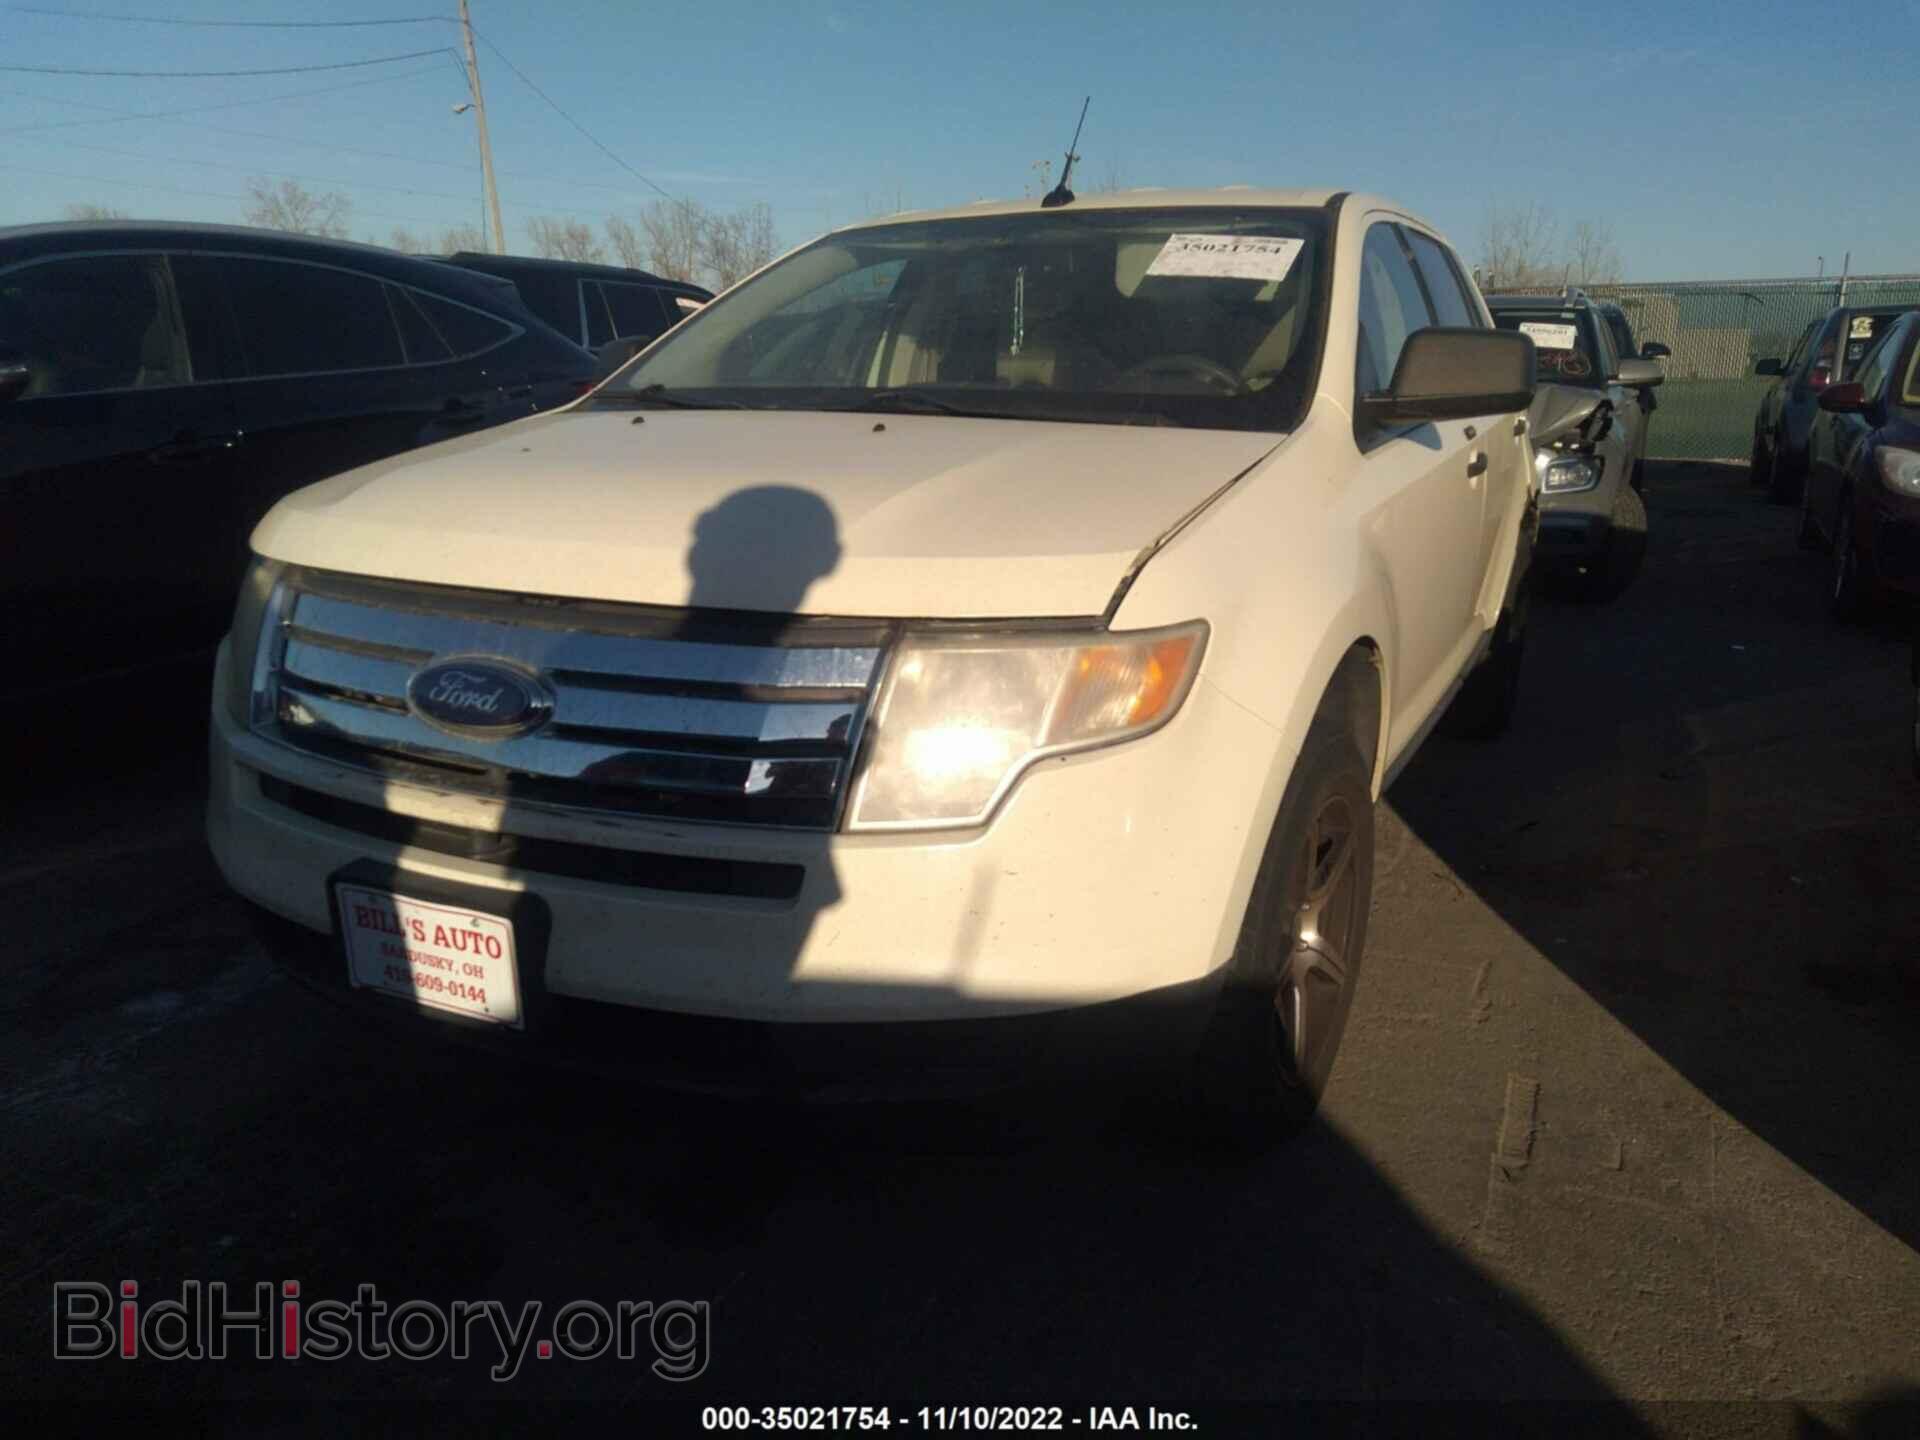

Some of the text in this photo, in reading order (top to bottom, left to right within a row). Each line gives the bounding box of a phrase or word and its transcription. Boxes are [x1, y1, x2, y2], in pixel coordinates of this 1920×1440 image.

[429, 670, 504, 712] Ford
[433, 924, 502, 960] AUTO
[463, 962, 484, 980] OH
